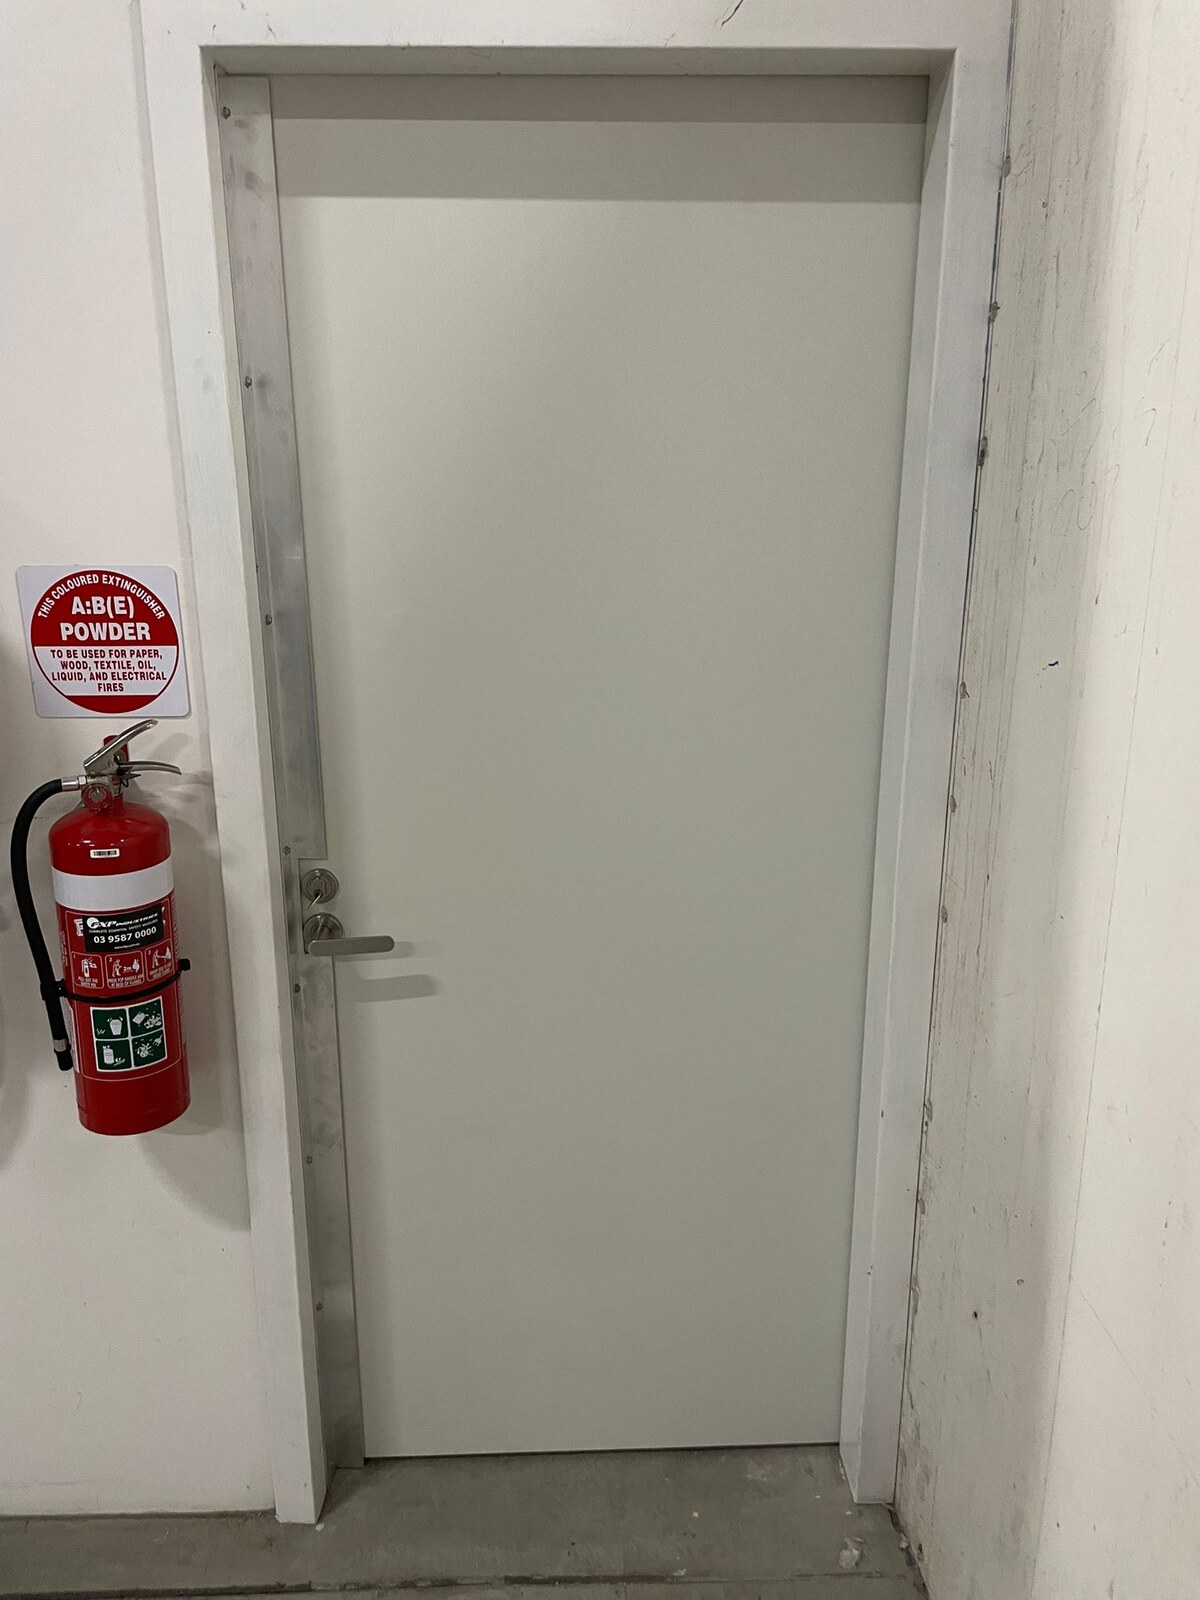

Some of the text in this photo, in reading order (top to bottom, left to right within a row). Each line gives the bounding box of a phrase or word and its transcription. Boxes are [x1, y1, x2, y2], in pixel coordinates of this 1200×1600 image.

[38, 574, 165, 620] THIS COLOURED EXTINGUISHER
[71, 596, 135, 619] A:B(E)
[60, 622, 151, 641] POWDER
[50, 649, 163, 660] TO BE USED FOR PAPER,
[60, 660, 156, 671] WOOD, TEXTILE, OIL,
[51, 671, 167, 682] LIQUID, AND ELECTRICAL
[97, 682, 124, 692] FIRES
[93, 926, 157, 944] 03 9587 0000
